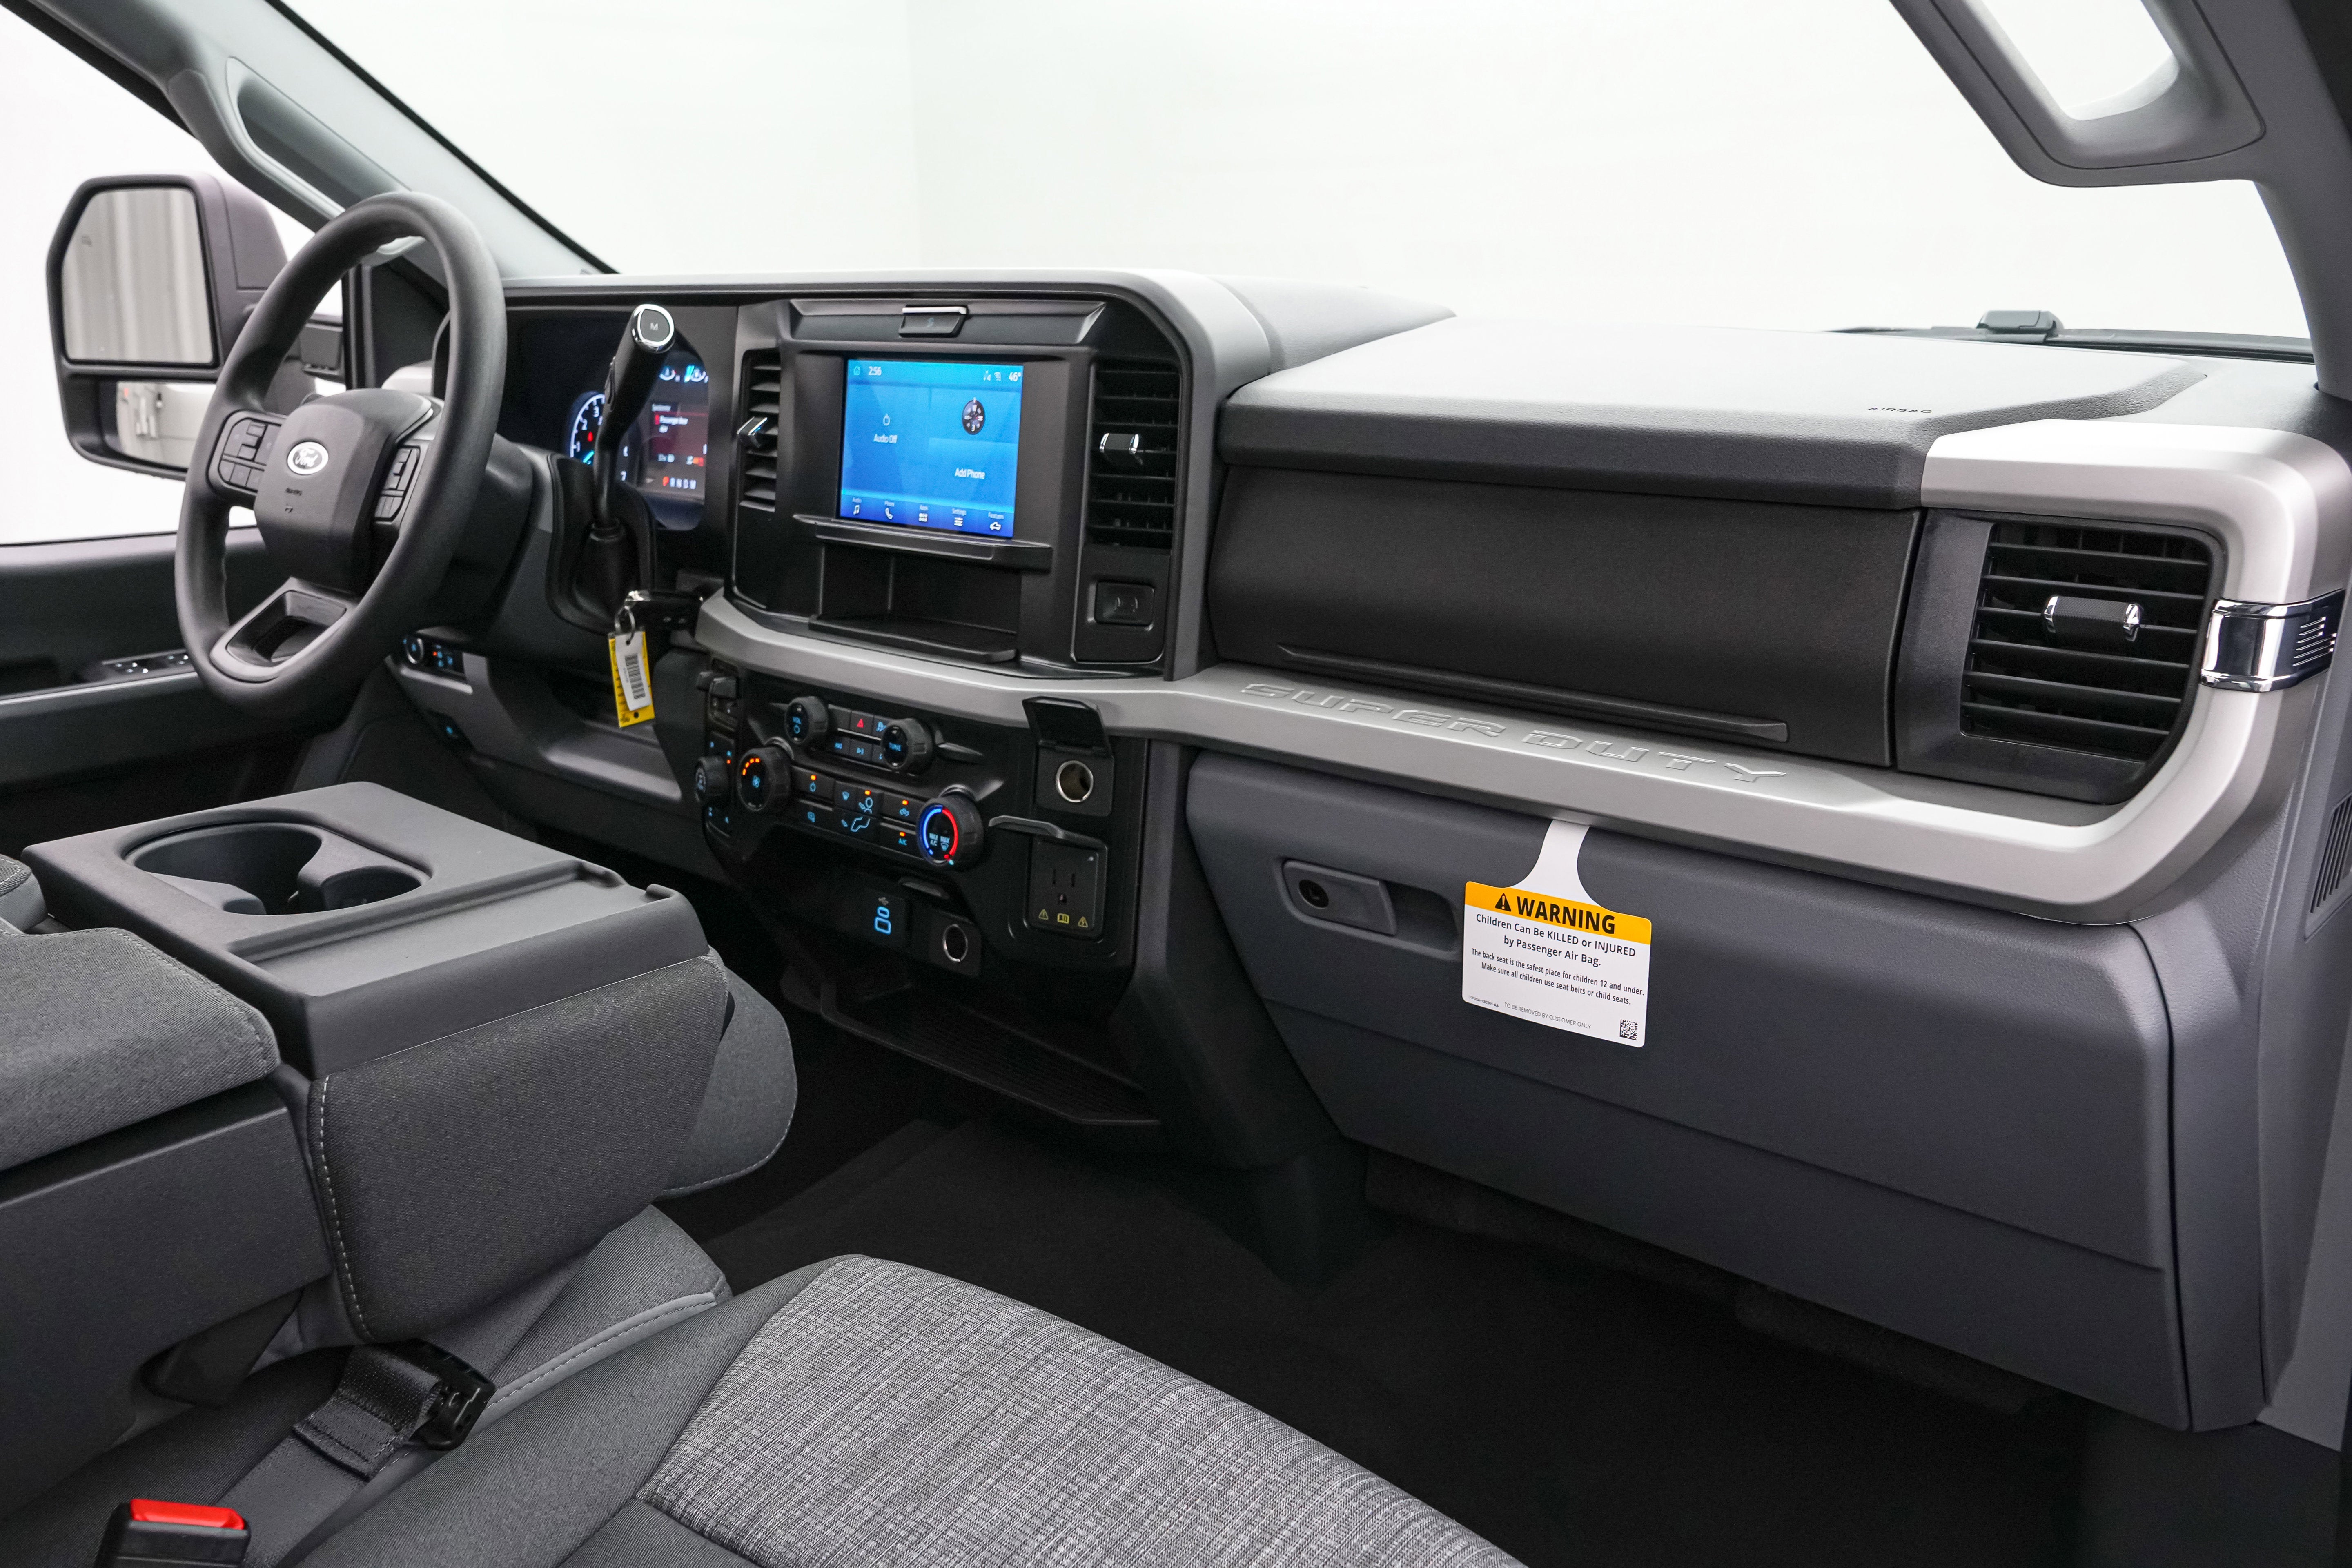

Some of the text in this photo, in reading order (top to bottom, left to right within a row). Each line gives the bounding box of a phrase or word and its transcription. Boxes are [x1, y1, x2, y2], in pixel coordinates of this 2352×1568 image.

[650, 322, 659, 331] M
[955, 468, 986, 479] Add Phone
[1240, 683, 1787, 783] SUPER DUTY
[1516, 895, 1615, 934] WARNING
[1476, 914, 1512, 930] Children
[1515, 923, 1531, 934] Can
[1533, 927, 1544, 938] Be
[1547, 931, 1579, 945] KILLED
[1595, 940, 1636, 957] INJURED
[1504, 935, 1601, 968] by Passenger Air Bag.
[1472, 948, 1481, 957] The
[1483, 951, 1495, 961] back
[1510, 958, 1514, 966] is
[1516, 960, 1525, 969] the
[1526, 964, 1544, 973] safest
[1545, 967, 1561, 977] place
[1563, 971, 1571, 980] for
[1573, 974, 1598, 986] children
[1600, 980, 1607, 988] 12
[1623, 986, 1644, 996] under.
[1481, 962, 1497, 972] Make
[1498, 968, 1510, 976] sure
[1519, 973, 1543, 985] children
[1556, 982, 1568, 991] seat
[1570, 984, 1585, 995] belts
[1596, 991, 1611, 1000] child
[1613, 996, 1631, 1005] seats.
[1518, 1007, 1541, 1017] REMOVED
[1549, 1015, 1576, 1026] CUSTOMER
